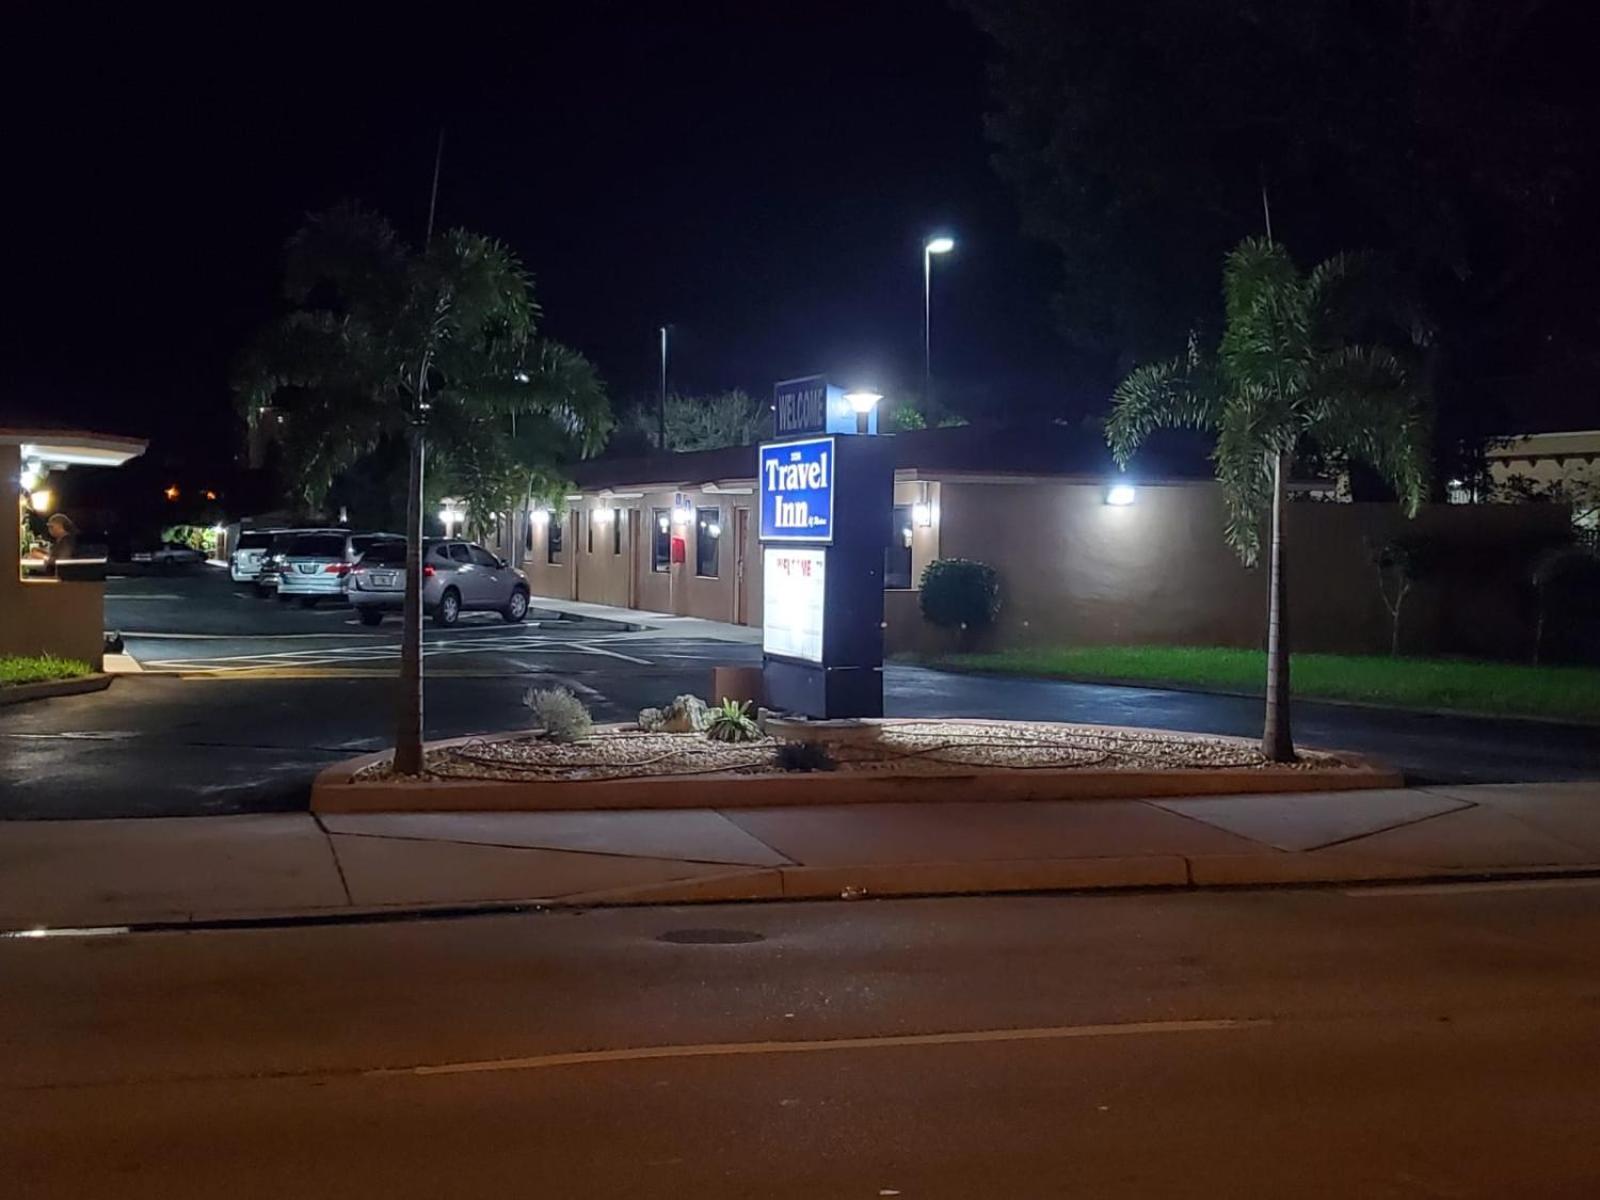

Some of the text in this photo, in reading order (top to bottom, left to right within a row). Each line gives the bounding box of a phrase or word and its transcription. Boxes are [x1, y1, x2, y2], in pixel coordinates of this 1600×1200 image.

[778, 389, 823, 431] WELCOME
[766, 452, 828, 491] Travel
[775, 496, 808, 527] Inn
[777, 558, 811, 577] WELME
